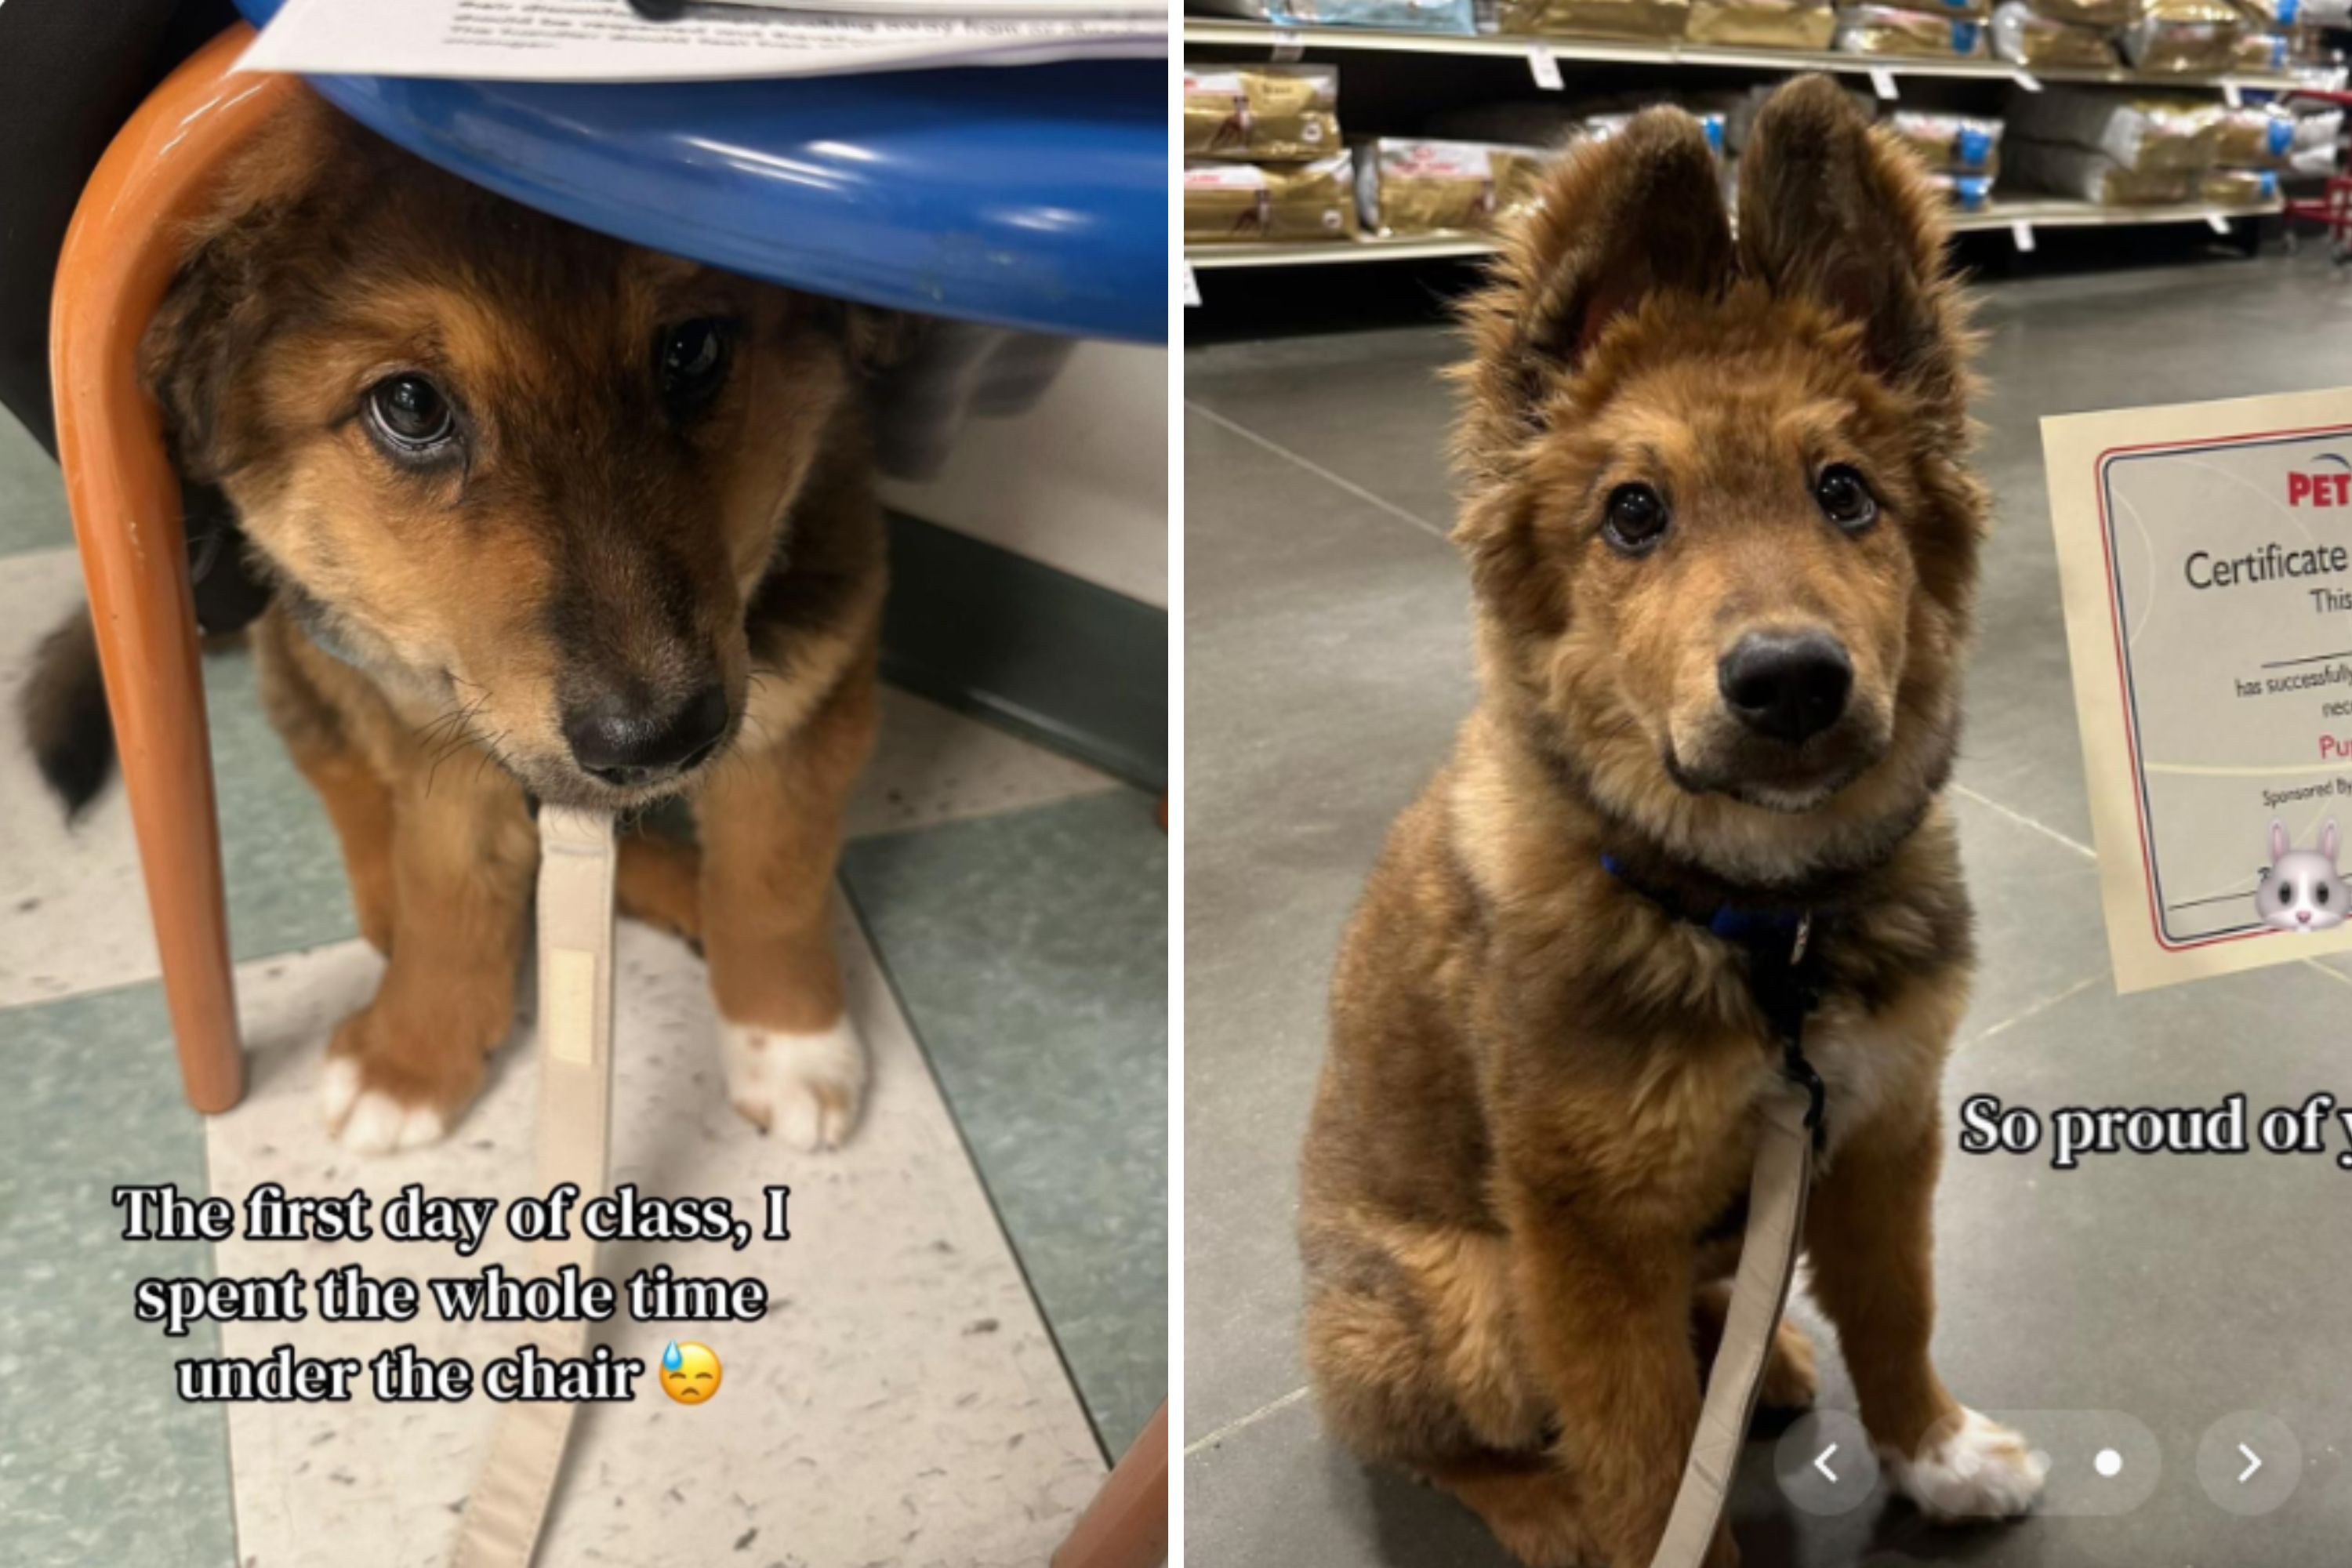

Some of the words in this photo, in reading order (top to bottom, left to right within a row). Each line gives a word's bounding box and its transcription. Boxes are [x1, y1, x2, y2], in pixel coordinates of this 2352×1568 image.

[2288, 471, 2352, 507] PET
[2185, 542, 2348, 589] Certificate
[2309, 587, 2352, 613] This
[2235, 678, 2262, 698] has
[2267, 664, 2352, 694] successfully
[2321, 698, 2352, 718] nec
[2318, 734, 2352, 760] Pu
[2263, 780, 2333, 809] Sponsored
